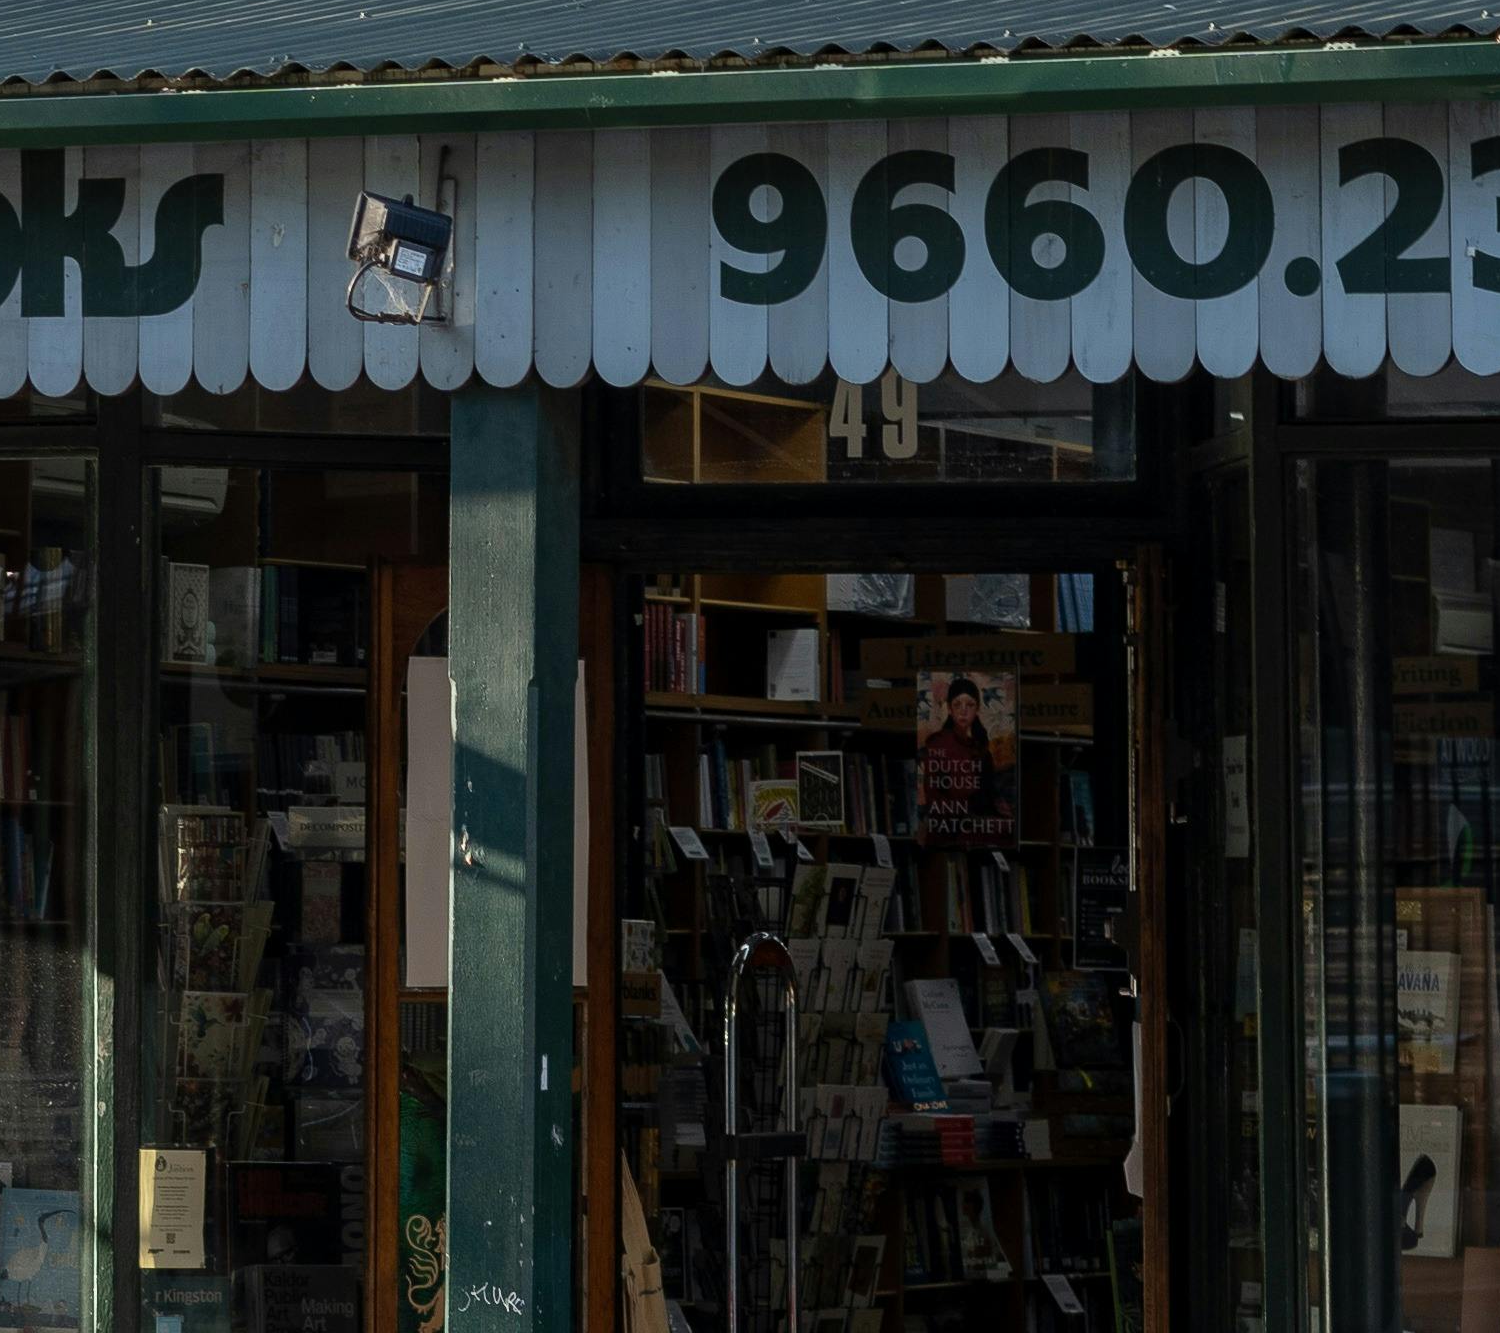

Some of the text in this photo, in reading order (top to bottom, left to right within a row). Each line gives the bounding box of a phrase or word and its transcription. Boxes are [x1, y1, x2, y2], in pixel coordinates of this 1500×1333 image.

[829, 379, 919, 460] 49
[904, 645, 1044, 667] Literature
[928, 749, 947, 759] THE
[928, 759, 983, 774] DUTCH
[928, 775, 983, 790] HOUSE
[929, 799, 969, 815] ANN
[928, 818, 1016, 835] PATCHETT
[163, 1288, 223, 1306] Kingston
[301, 1297, 355, 1318] Making
[302, 1316, 328, 1332] Art
